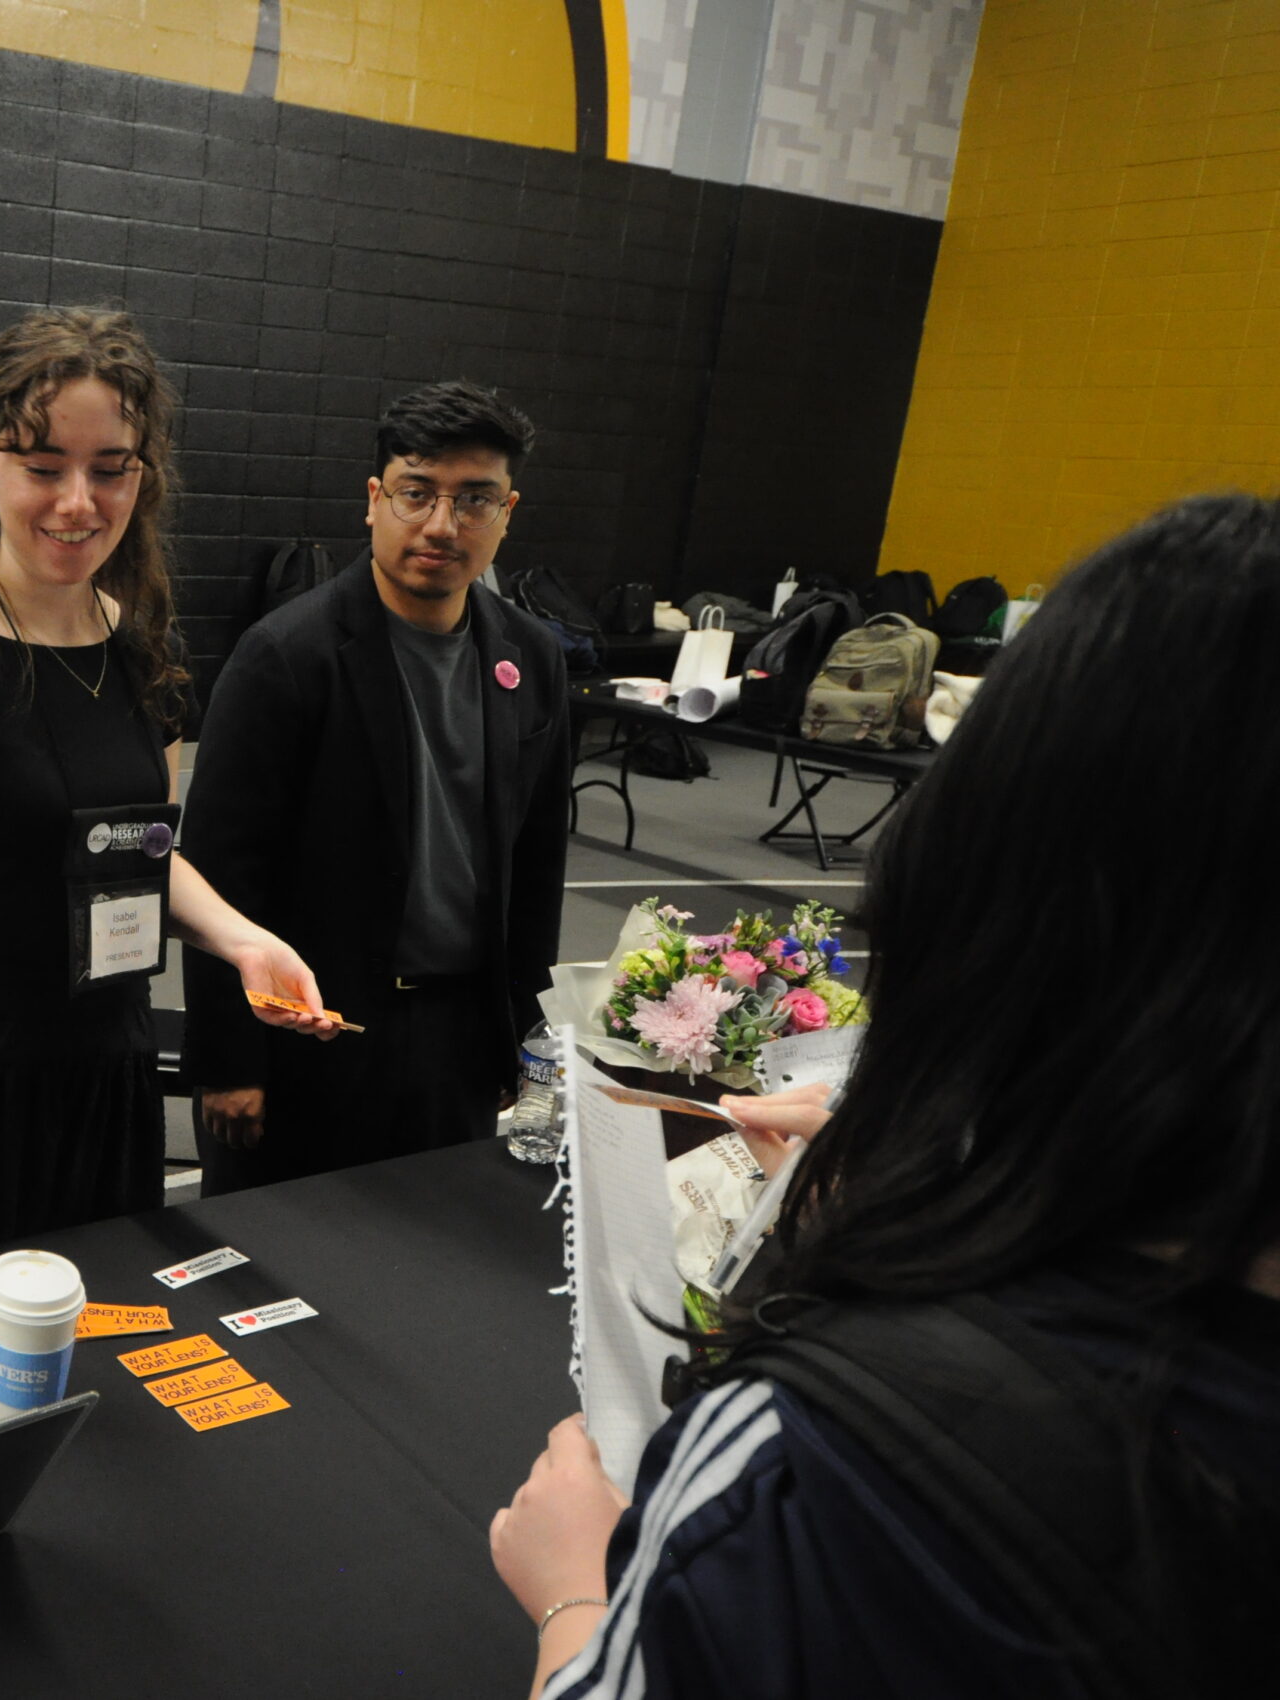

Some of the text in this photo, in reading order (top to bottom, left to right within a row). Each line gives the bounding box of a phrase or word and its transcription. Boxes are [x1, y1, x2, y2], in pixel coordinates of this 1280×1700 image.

[109, 924, 140, 937] Kendall
[112, 910, 138, 923] Isabel
[105, 950, 143, 962] PRESENTER
[161, 1275, 177, 1284] I
[184, 1252, 227, 1271] Missionary
[127, 1311, 164, 1319] YOUR
[228, 1301, 303, 1330] I Missionary
[125, 1338, 212, 1367] WHAT IS
[131, 1348, 208, 1373] YOUR LENS?
[151, 1364, 240, 1394] WHAT IS
[158, 1374, 238, 1402] YOUR LENS?
[183, 1388, 274, 1418] WHAT IS
[191, 1398, 272, 1426] YOUR LENS?
